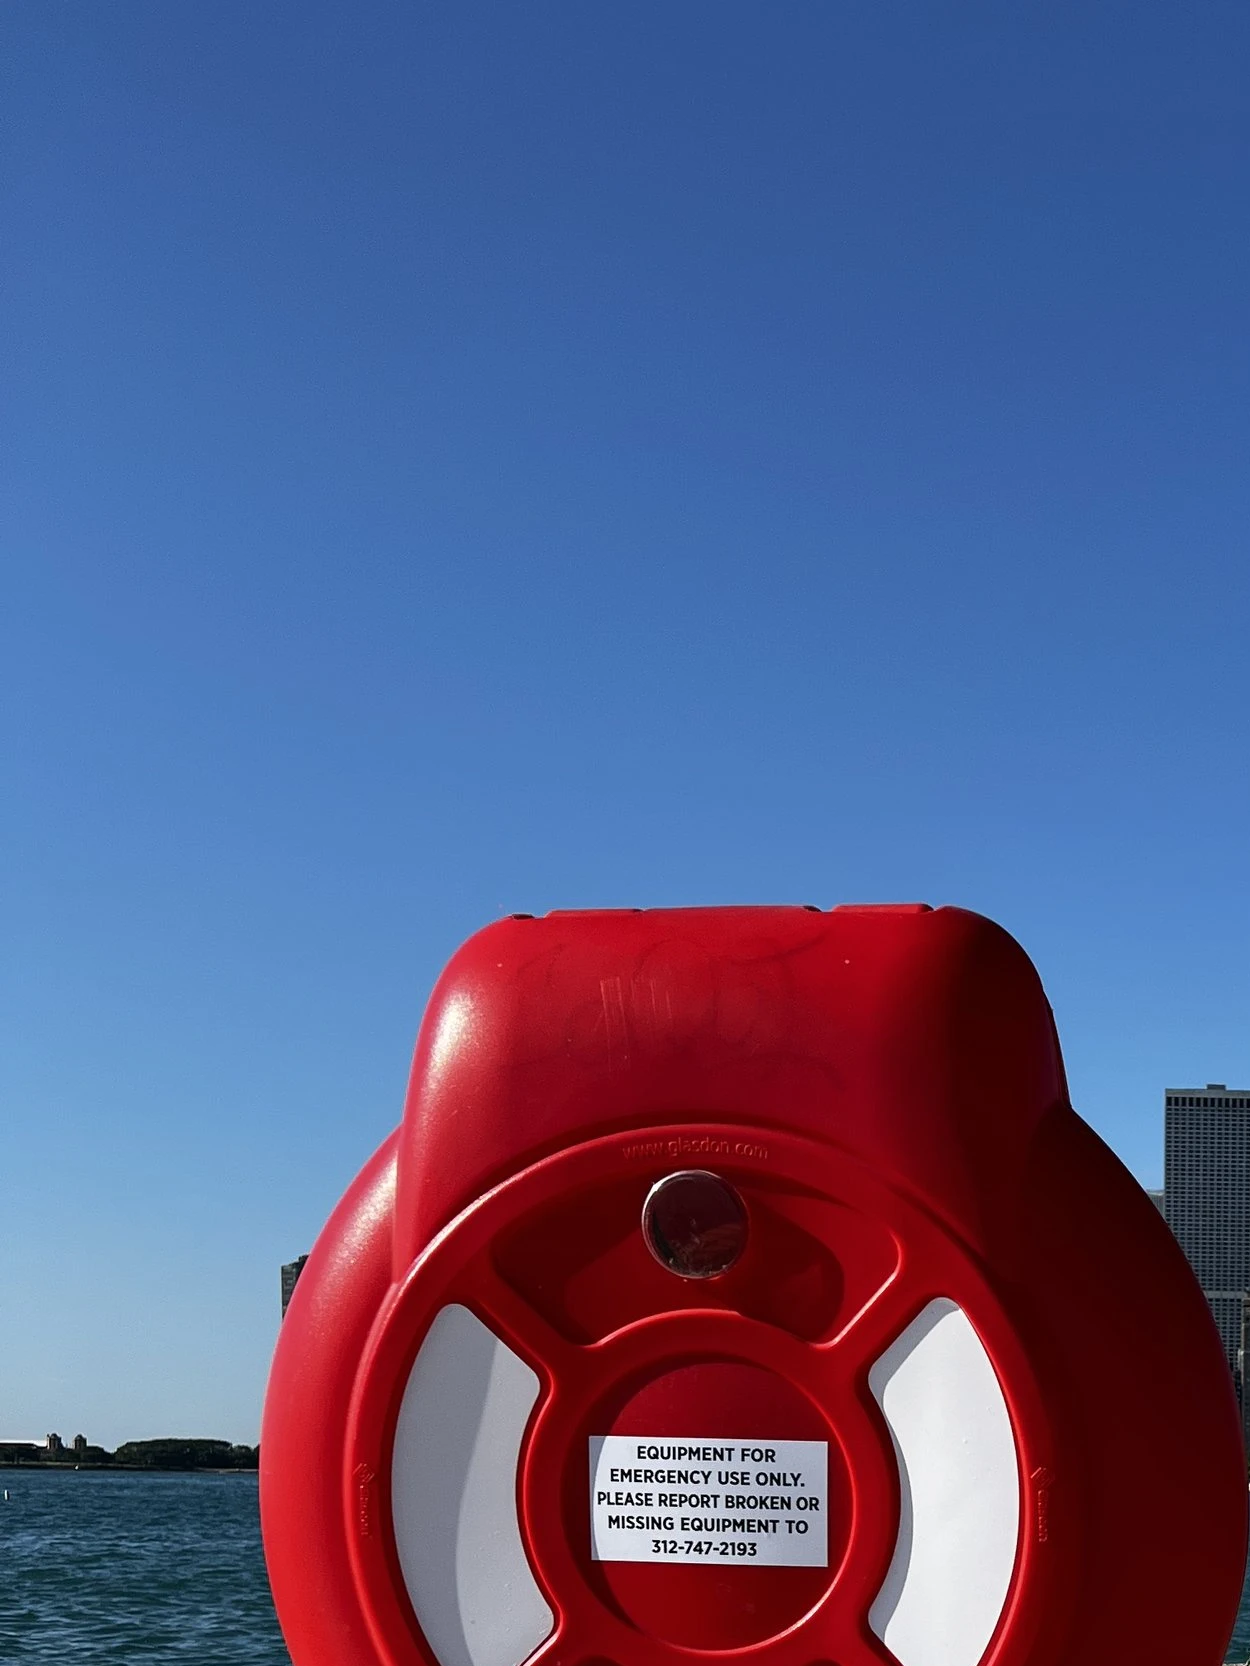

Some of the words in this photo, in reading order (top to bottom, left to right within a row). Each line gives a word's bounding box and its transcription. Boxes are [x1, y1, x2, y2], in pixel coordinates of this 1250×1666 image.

[623, 1136, 768, 1159] www.glasdon.com
[638, 1446, 735, 1461] EQUIPMENT
[741, 1448, 775, 1462] FOR
[611, 1469, 712, 1484] EMERGENCY
[718, 1471, 750, 1485] USE
[756, 1472, 805, 1487] ONLY.
[598, 1492, 653, 1506] PLEASE
[659, 1494, 720, 1508] REPORT
[725, 1495, 791, 1510] BROKEN
[796, 1497, 819, 1511] OR
[608, 1516, 674, 1530] MISSING
[681, 1518, 780, 1533] EQUIPMENT
[785, 1520, 808, 1534] TO
[652, 1540, 757, 1556] 312-747-2193
